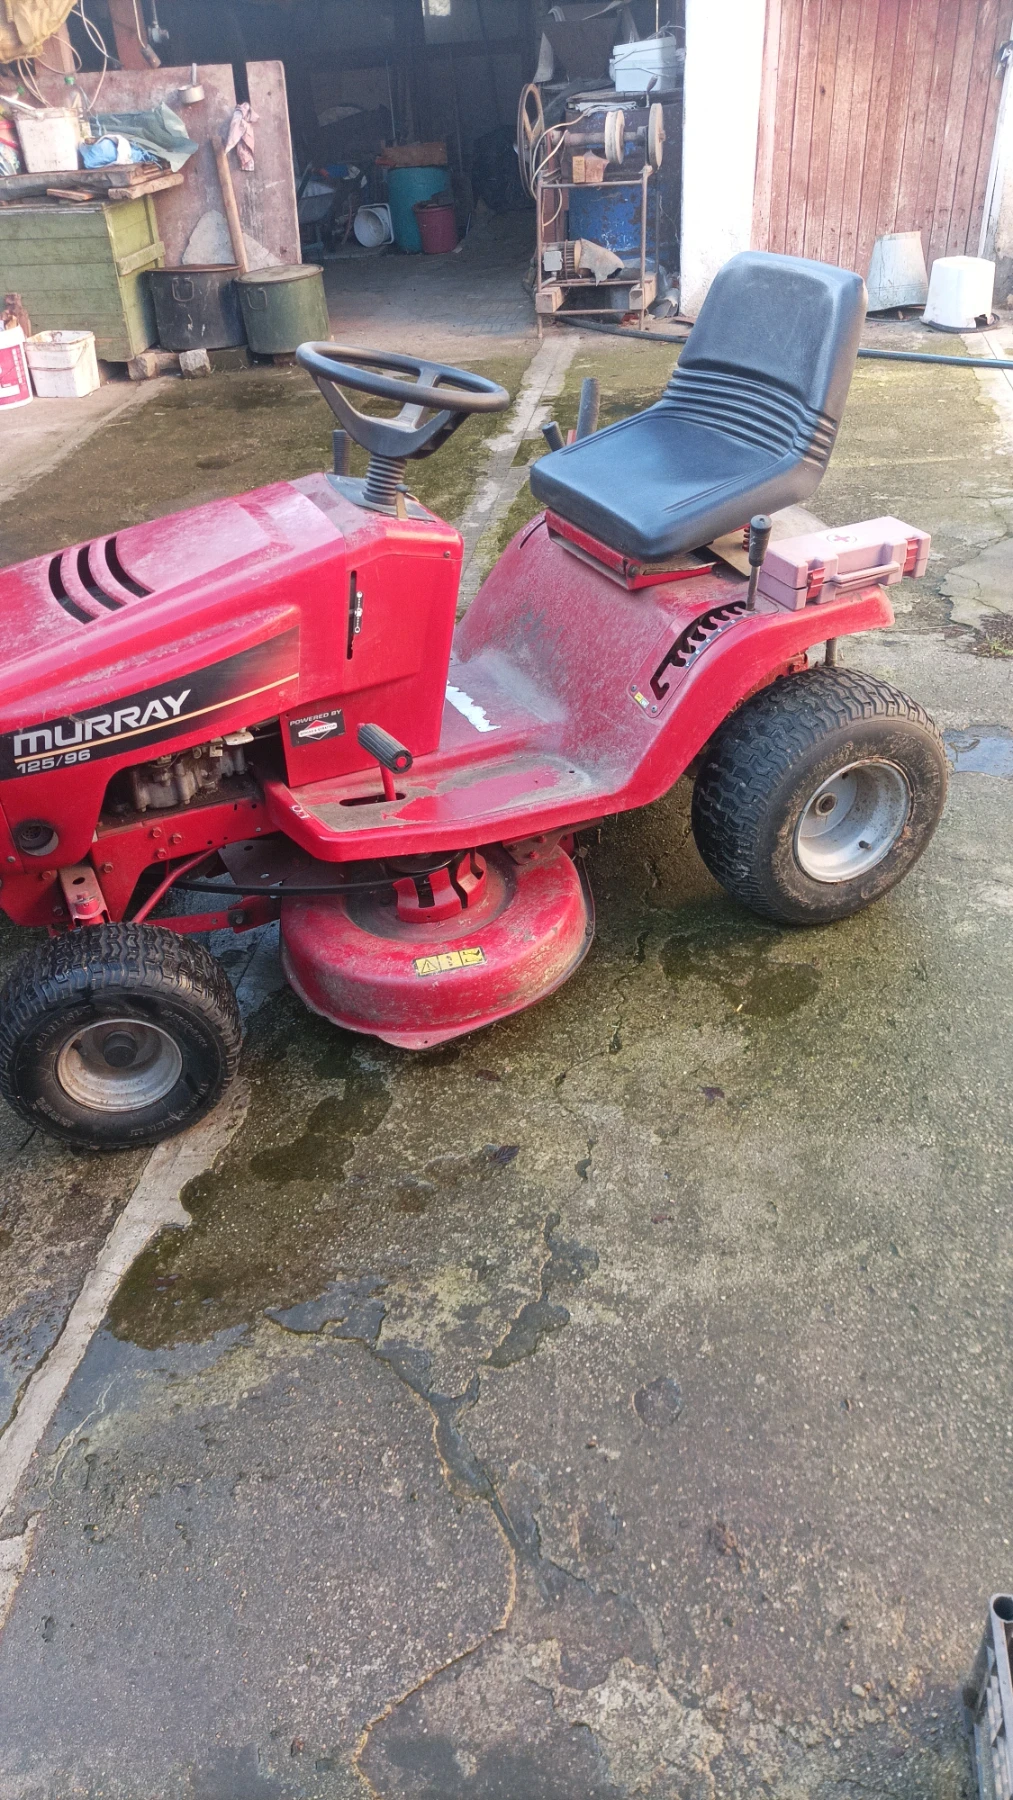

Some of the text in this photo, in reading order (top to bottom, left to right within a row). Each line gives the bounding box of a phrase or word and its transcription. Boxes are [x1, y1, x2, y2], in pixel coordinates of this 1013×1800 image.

[13, 689, 191, 756] MURRAY
[290, 712, 329, 726] POWERED
[16, 749, 91, 774] 125/96
